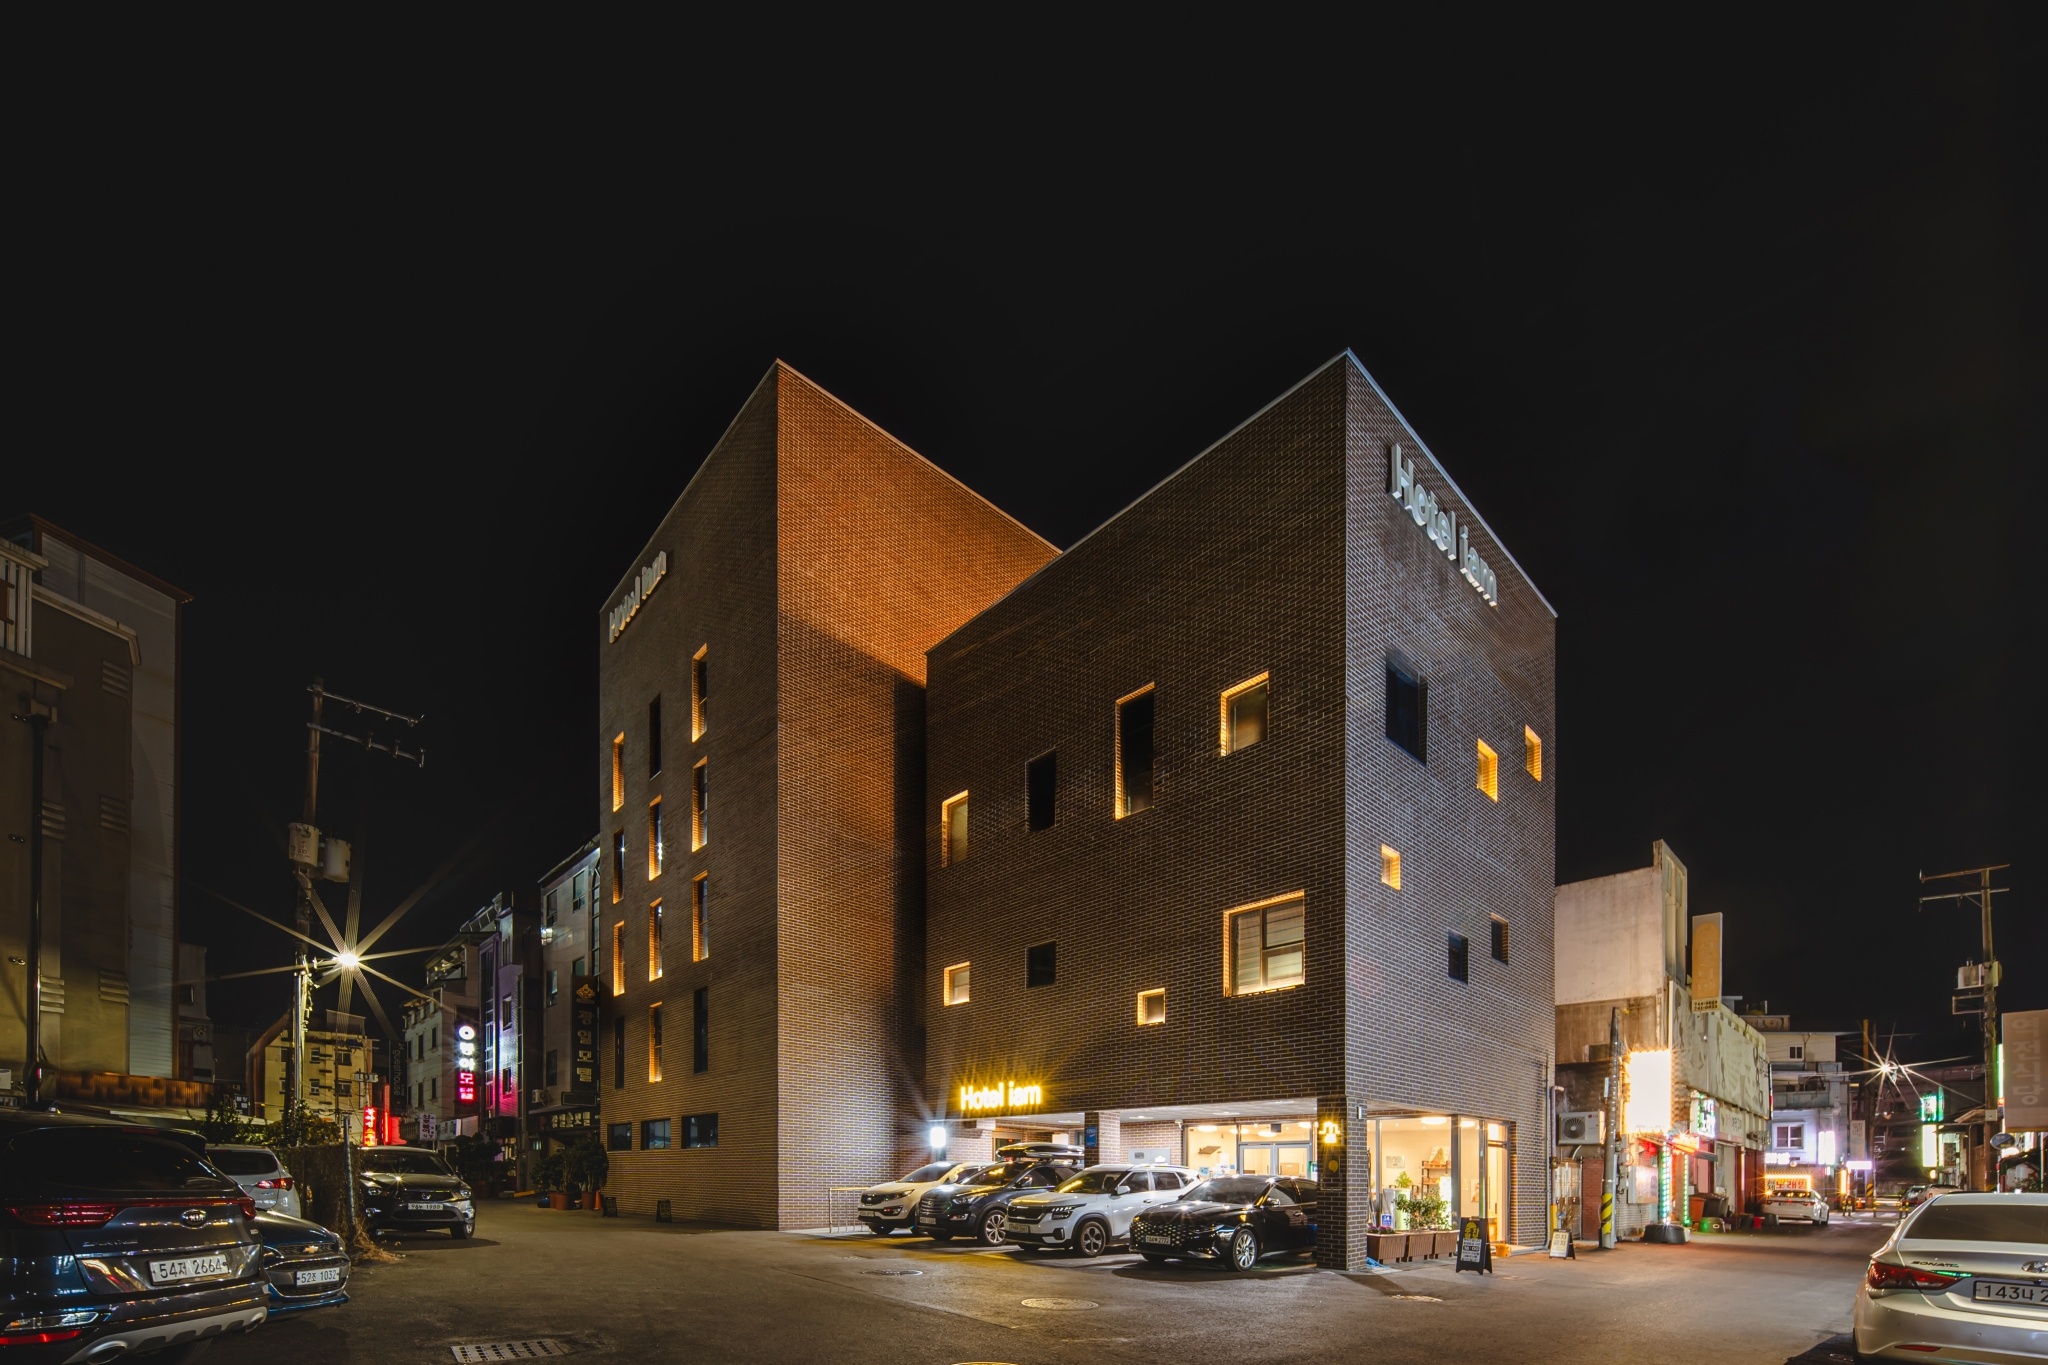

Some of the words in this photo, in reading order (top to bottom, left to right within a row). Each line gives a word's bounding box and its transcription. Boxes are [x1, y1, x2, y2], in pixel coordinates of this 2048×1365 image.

[1391, 444, 1457, 560] Hotel
[609, 575, 641, 644] Hotel
[576, 1010, 594, 1083] 광일모텔
[2011, 1016, 2044, 1105] 역전식당
[960, 1082, 1004, 1110] Hotel
[1008, 1081, 1042, 1107] iam
[1775, 1180, 1806, 1189] 노래방
[192, 1257, 222, 1275] 2664
[320, 1269, 337, 1281] 1032
